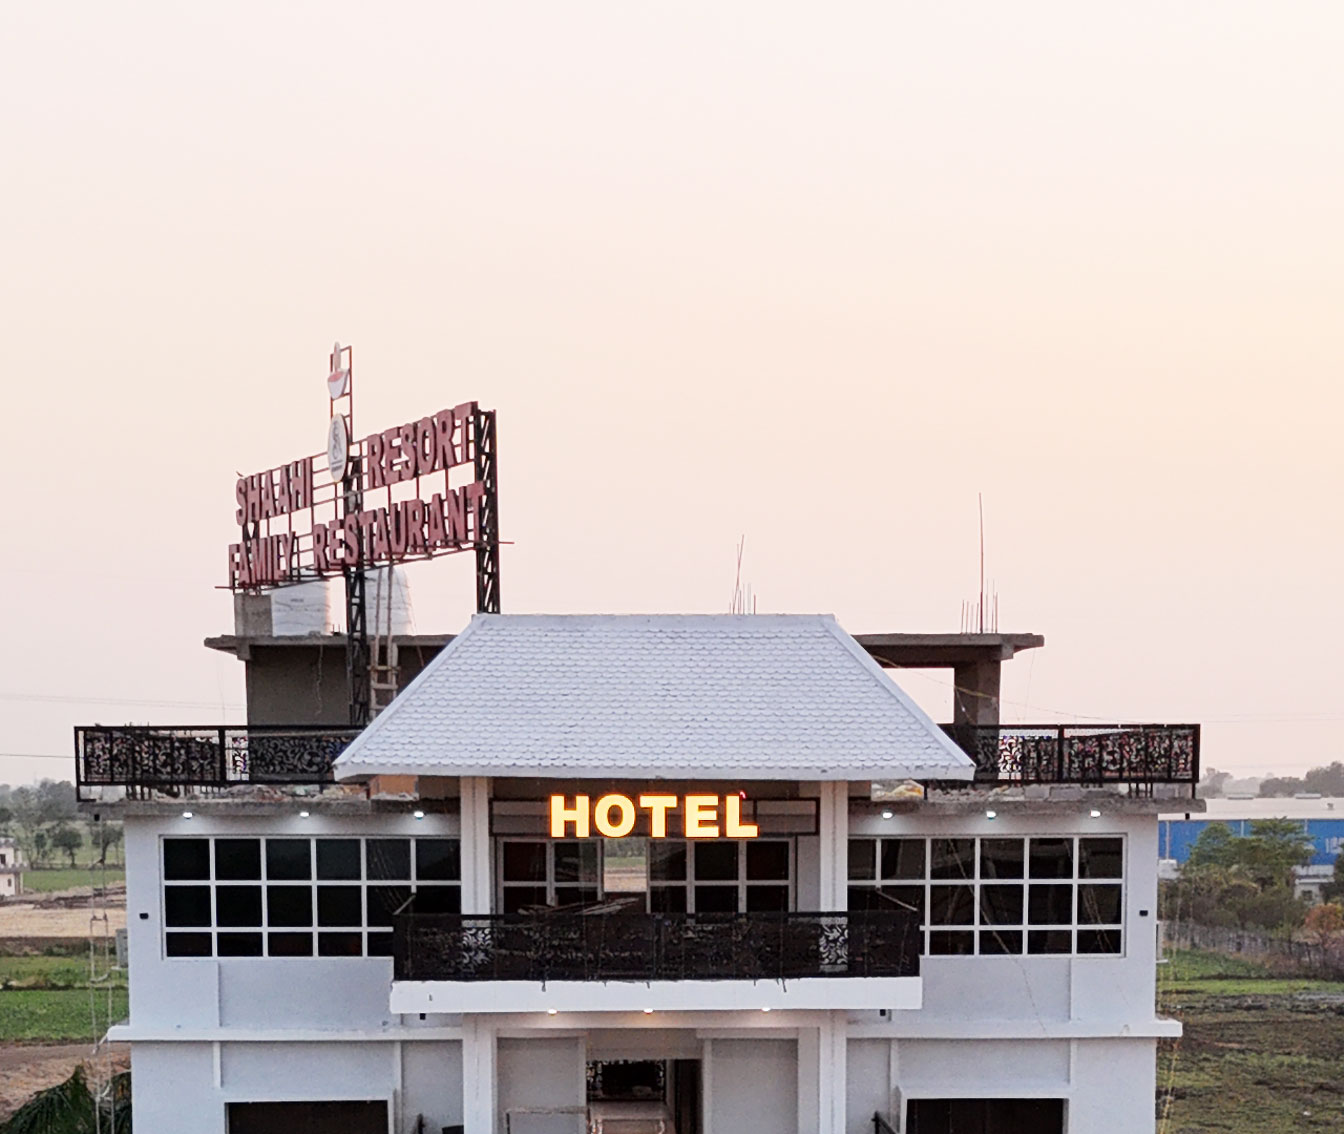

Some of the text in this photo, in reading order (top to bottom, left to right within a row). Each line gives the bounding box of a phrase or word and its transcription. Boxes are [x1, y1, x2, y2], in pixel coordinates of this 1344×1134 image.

[236, 457, 312, 526] SHAAHI
[367, 401, 478, 488] RESORT
[229, 481, 484, 587] FAMILY RESTAURANT
[550, 794, 758, 838] HOTEL
